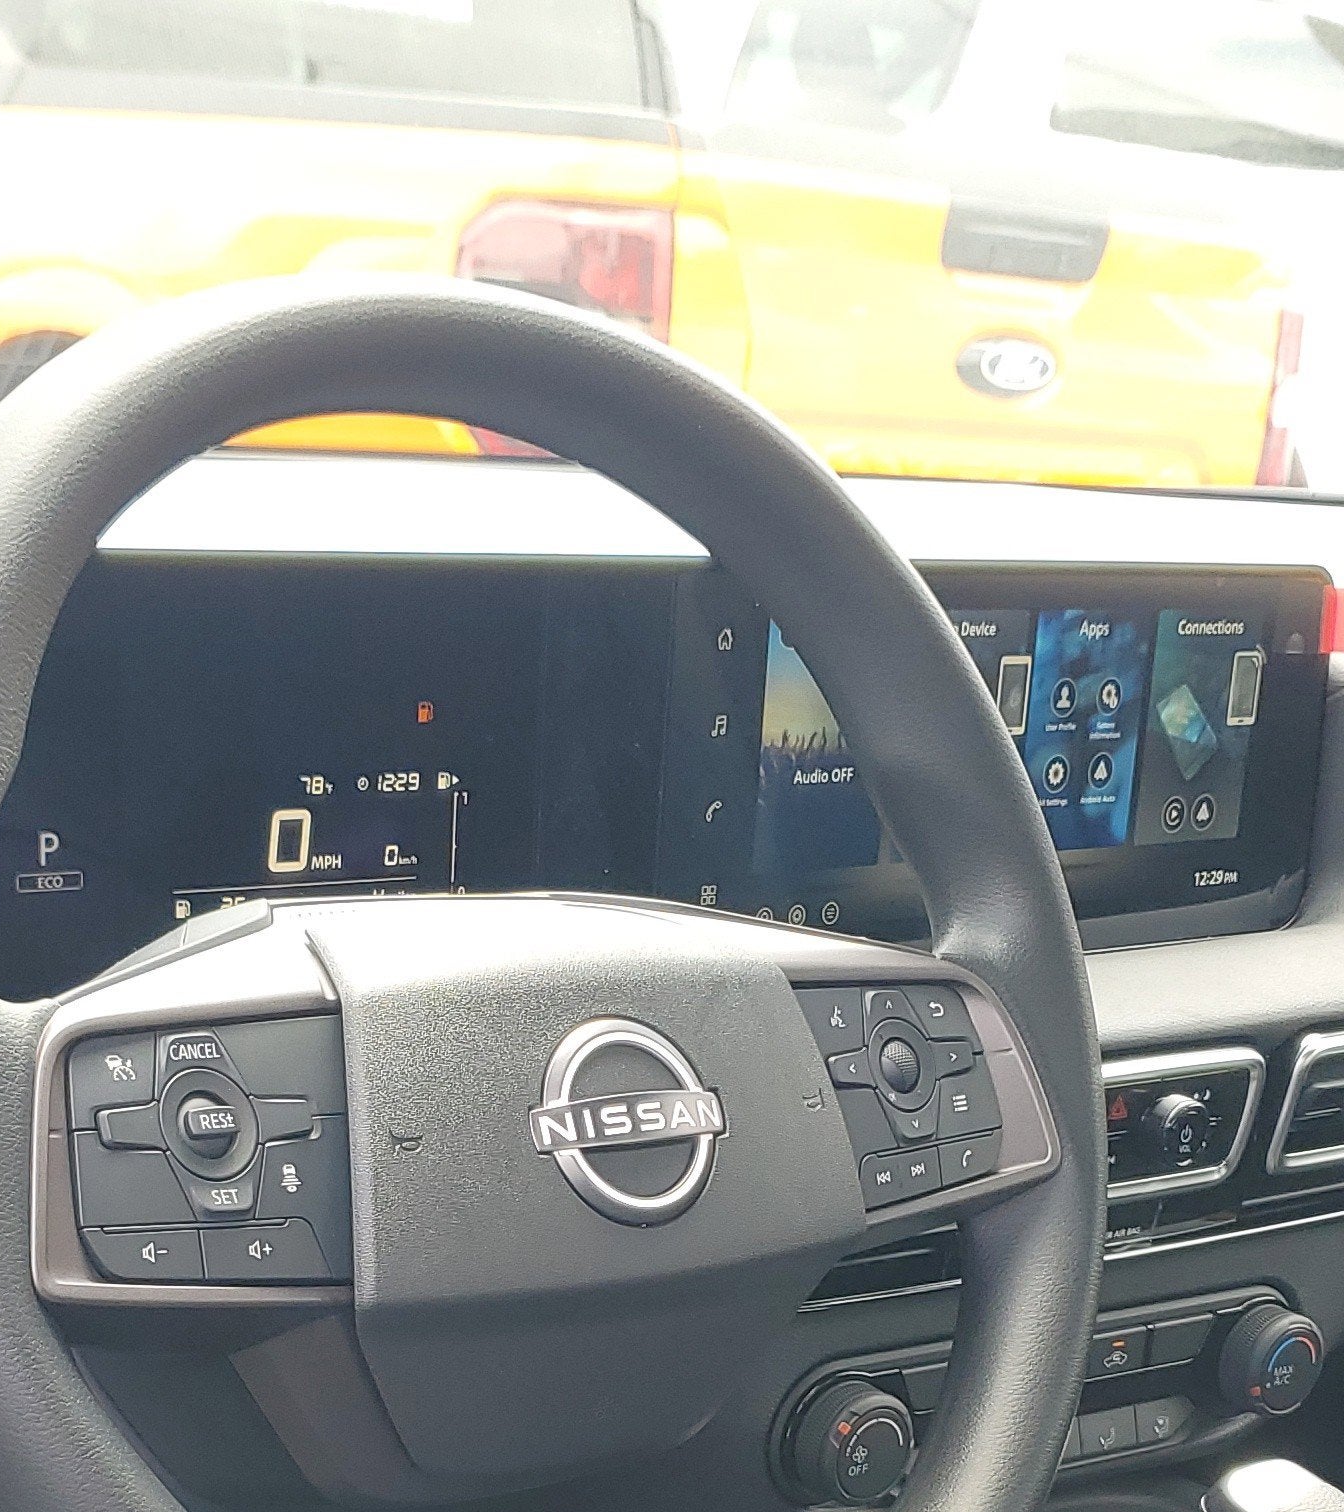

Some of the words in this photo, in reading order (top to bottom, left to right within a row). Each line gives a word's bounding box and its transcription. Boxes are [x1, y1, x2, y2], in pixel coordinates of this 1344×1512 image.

[961, 621, 997, 637] Device
[1079, 620, 1110, 638] Apps
[1178, 620, 1245, 636] Connections
[793, 769, 829, 785] Audio
[831, 767, 854, 783] OFF
[38, 831, 61, 867] P
[310, 853, 343, 871] MPH
[37, 875, 64, 889] ECO
[1194, 869, 1224, 887] 12:29
[168, 1042, 222, 1062] CANCEL
[538, 1098, 722, 1147] NISSAN
[210, 1187, 240, 1206] SET
[1273, 1364, 1294, 1377] MAX
[1273, 1374, 1291, 1386] A/C
[848, 1463, 869, 1477] OFF
